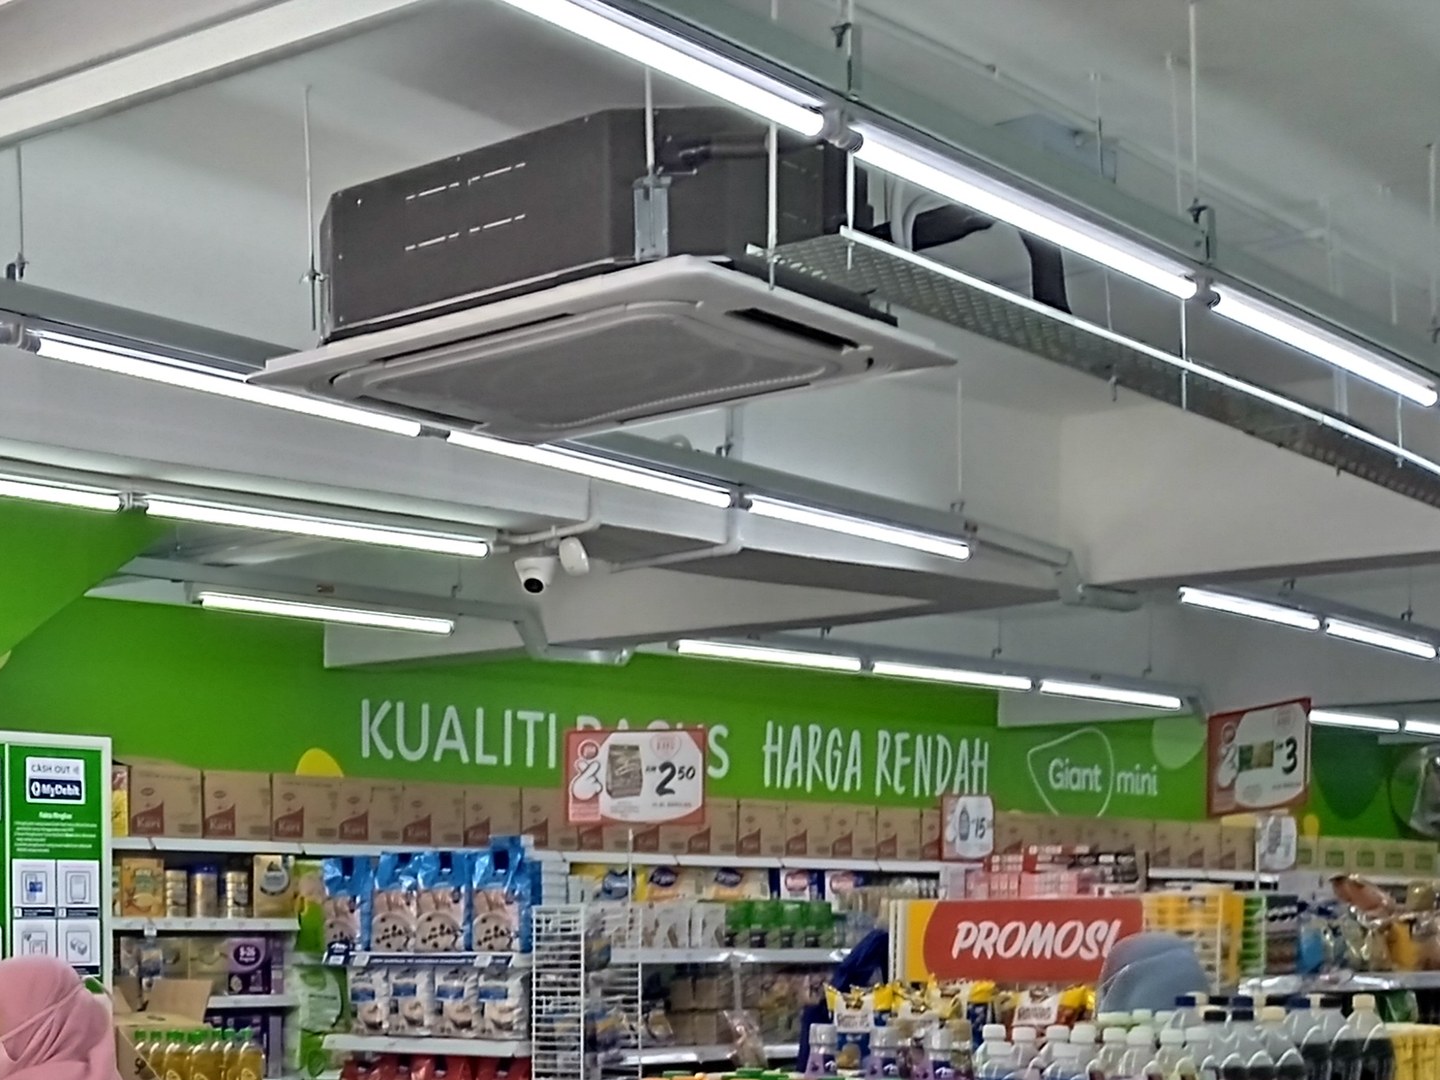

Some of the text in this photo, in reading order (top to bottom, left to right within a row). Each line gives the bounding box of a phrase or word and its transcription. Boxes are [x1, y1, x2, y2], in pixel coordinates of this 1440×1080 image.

[360, 698, 557, 770] KUALITI
[30, 764, 70, 774] CASH OUT
[762, 720, 861, 792] HARGA
[875, 727, 990, 796] RENDAH
[1048, 758, 1158, 797] Giant mini
[41, 783, 81, 798] MyDebit
